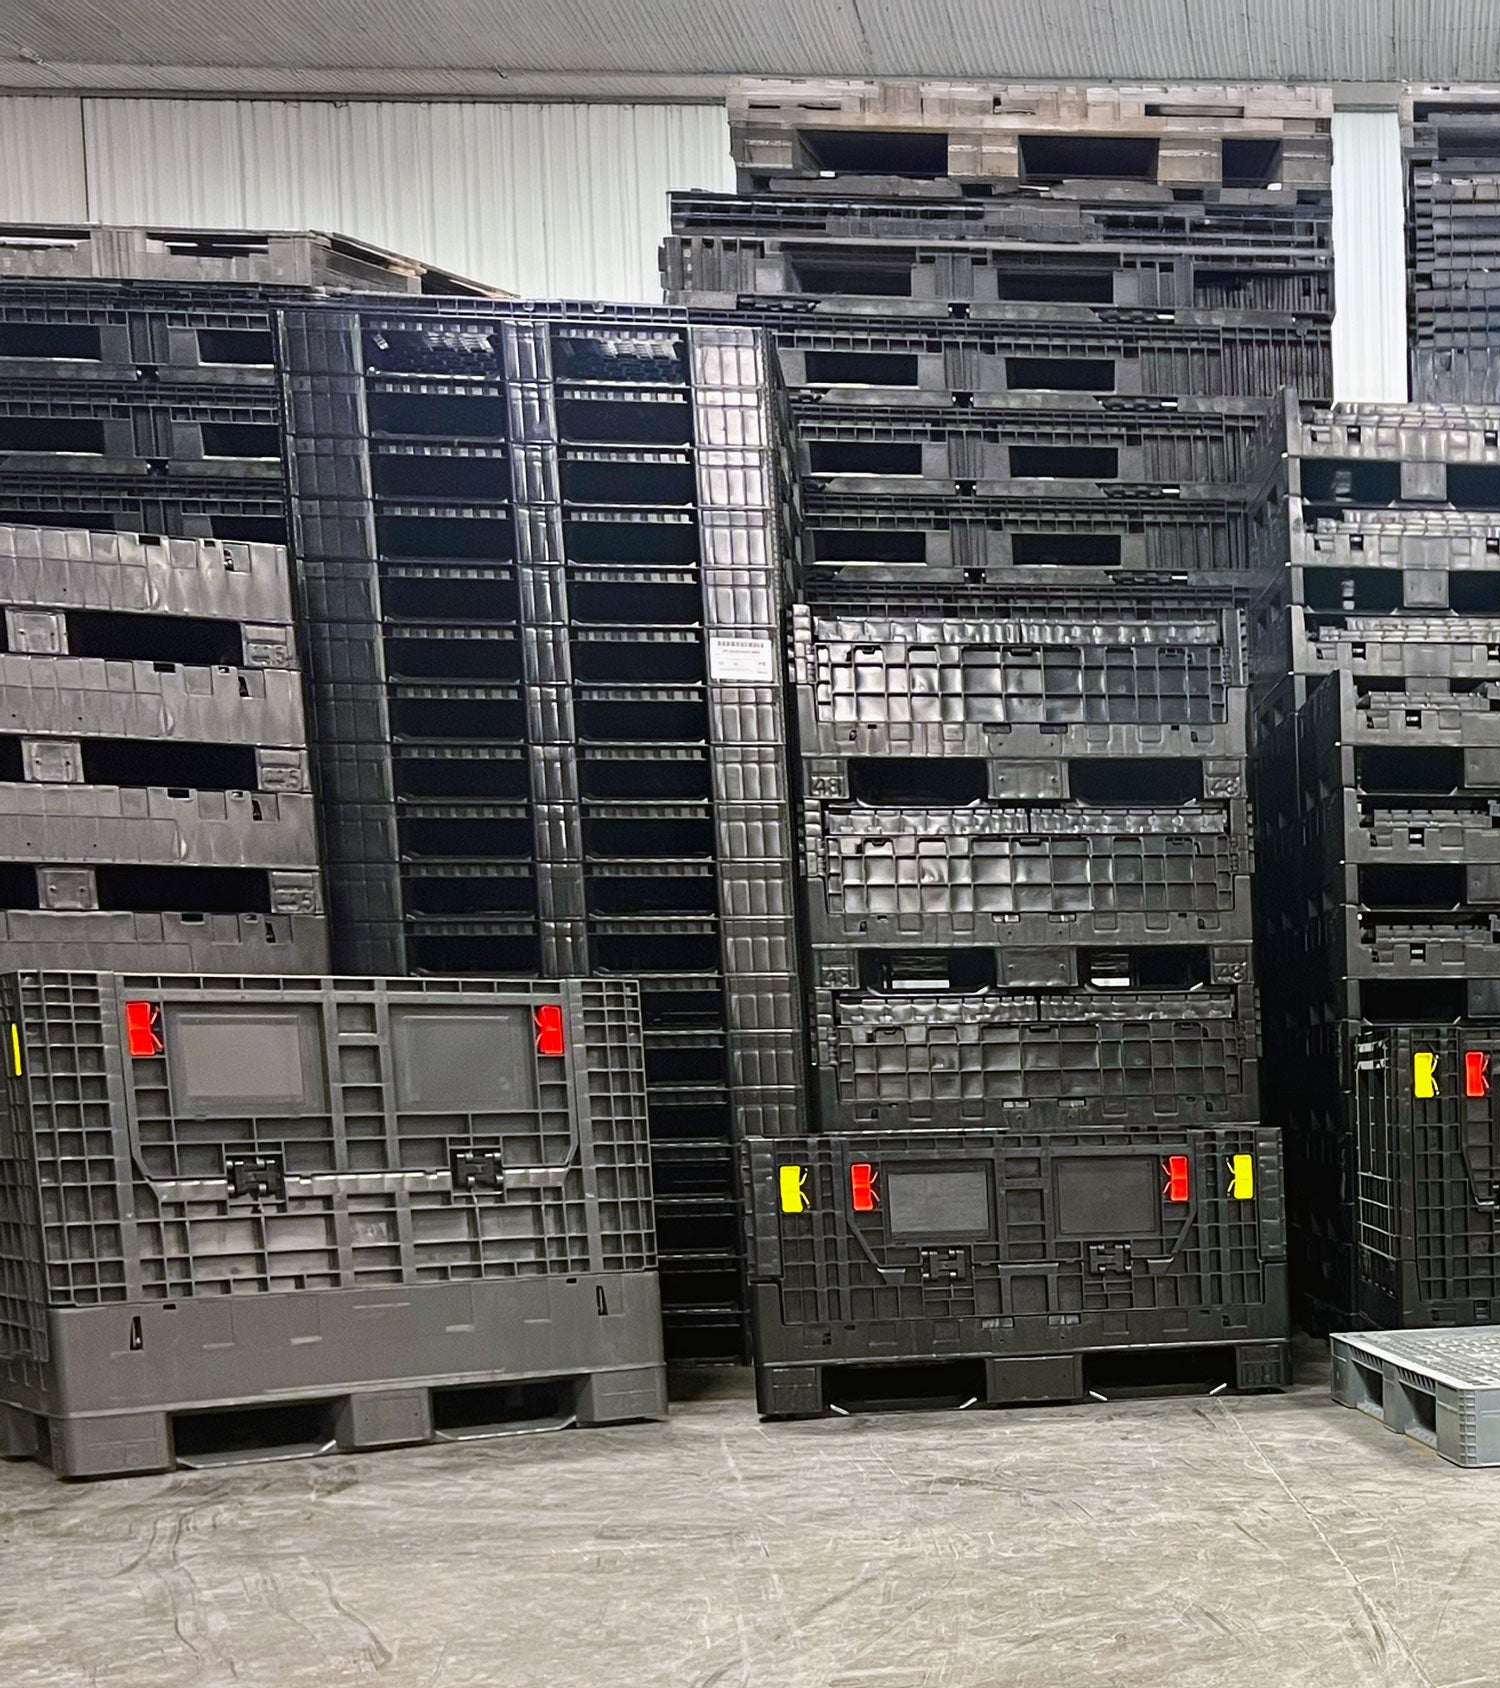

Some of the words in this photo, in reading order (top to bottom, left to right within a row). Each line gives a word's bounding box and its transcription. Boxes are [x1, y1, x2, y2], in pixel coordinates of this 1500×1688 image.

[813, 778, 839, 796] 48
[1210, 778, 1238, 796] 48
[1217, 963, 1246, 982] 48
